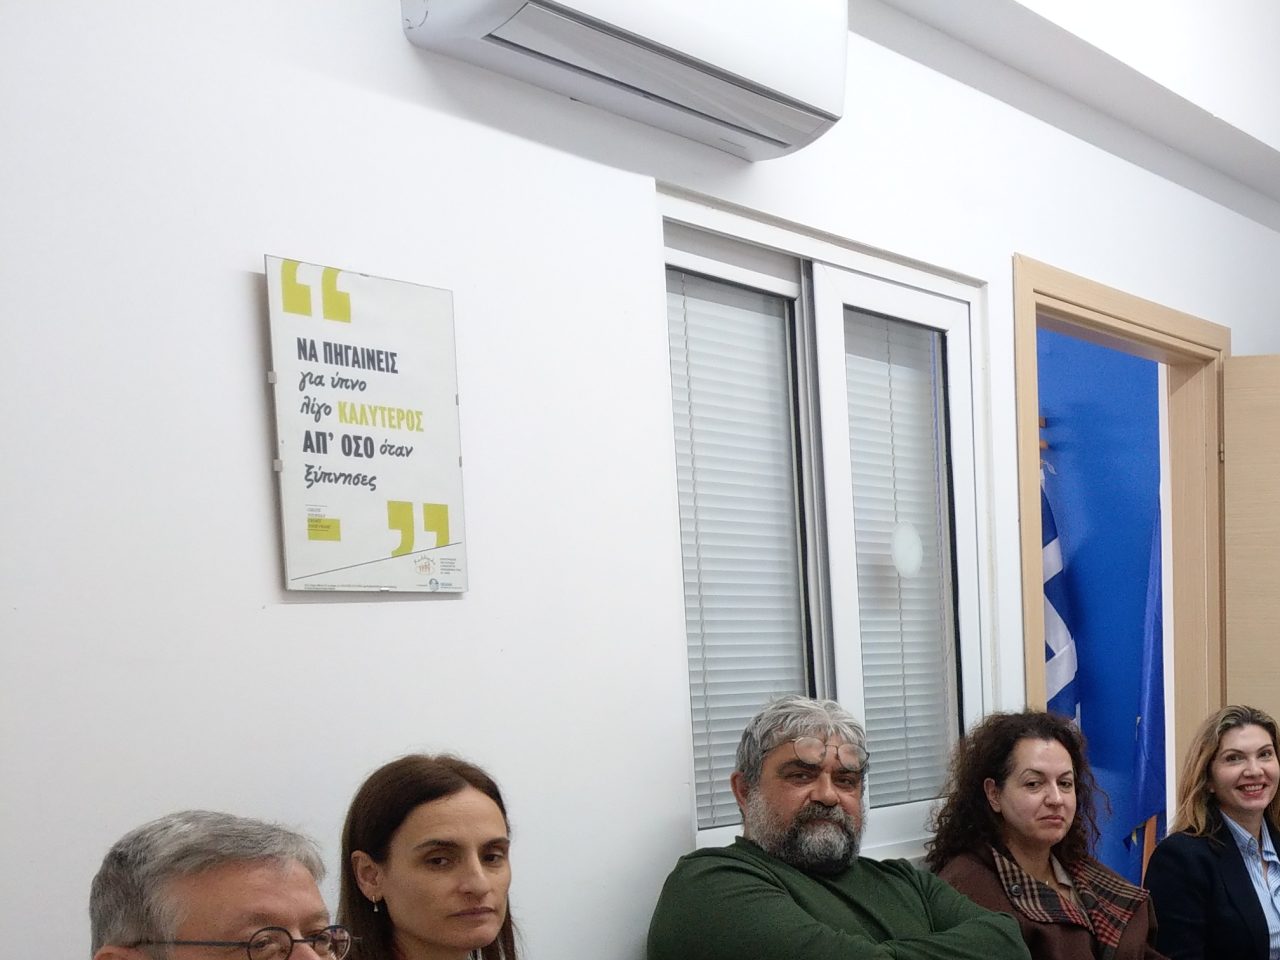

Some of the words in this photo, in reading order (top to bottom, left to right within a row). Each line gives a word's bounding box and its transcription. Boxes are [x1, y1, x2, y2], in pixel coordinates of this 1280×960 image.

[296, 337, 319, 363] ΝΑ
[322, 341, 399, 374] ΠΗΓΑΙΝΕΙΣ
[298, 371, 326, 392] για
[330, 371, 367, 392] ύπνο
[299, 395, 333, 423] λίγο
[337, 400, 425, 432] ΚΑΛΥΤΕΡΟΣ
[341, 434, 375, 459] ΟΣΟ
[379, 438, 414, 458] όταν
[304, 463, 377, 492] ξύπνησες
